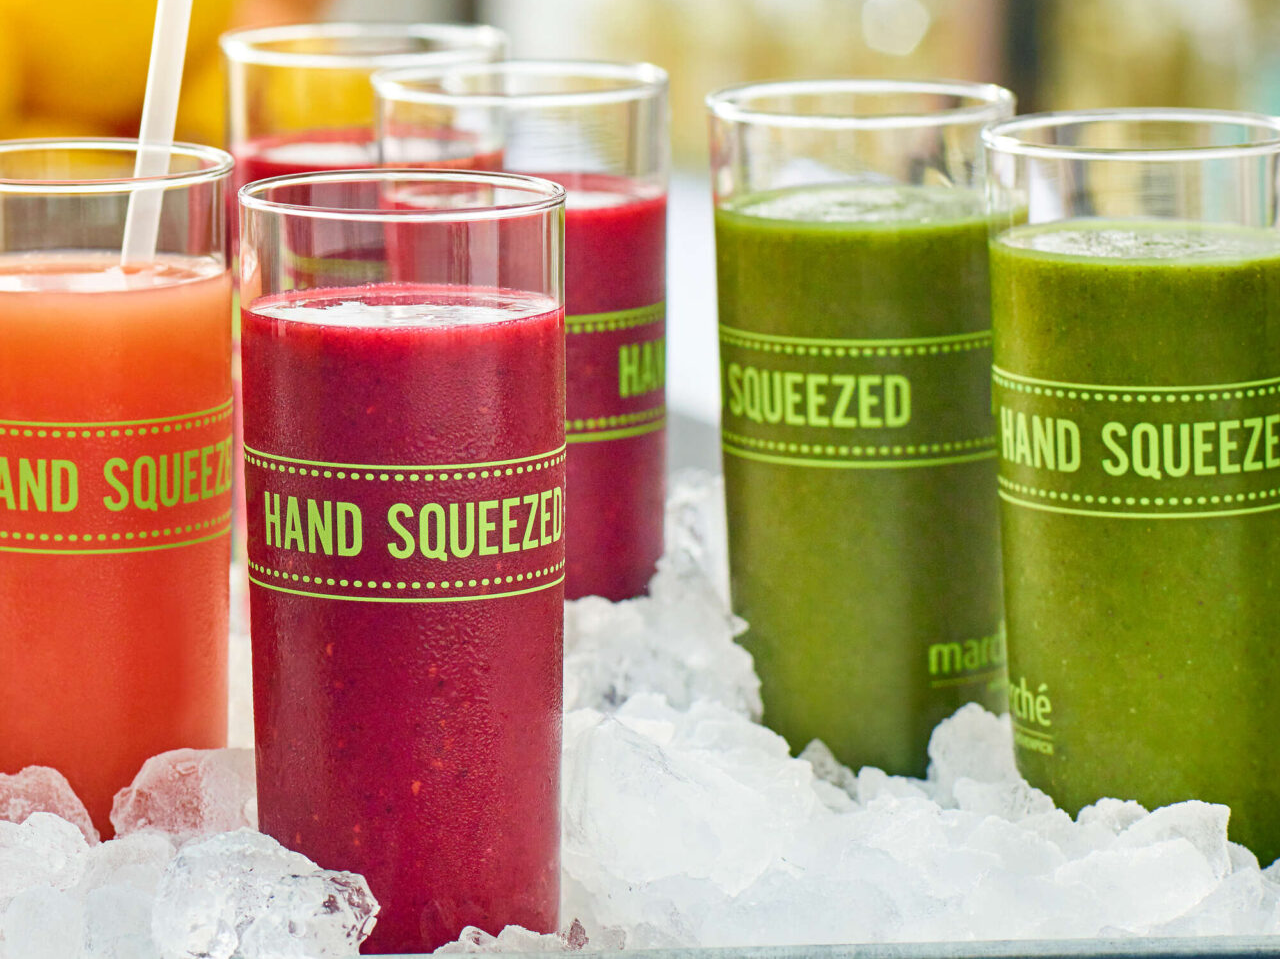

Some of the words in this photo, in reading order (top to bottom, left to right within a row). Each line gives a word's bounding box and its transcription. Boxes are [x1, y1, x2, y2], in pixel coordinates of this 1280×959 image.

[727, 362, 913, 429] SQUEEZED
[1000, 404, 1081, 474] HAND
[1100, 412, 1280, 481] SQUEEZE
[263, 490, 363, 558] HAND
[386, 485, 563, 563] SQUEEZED
